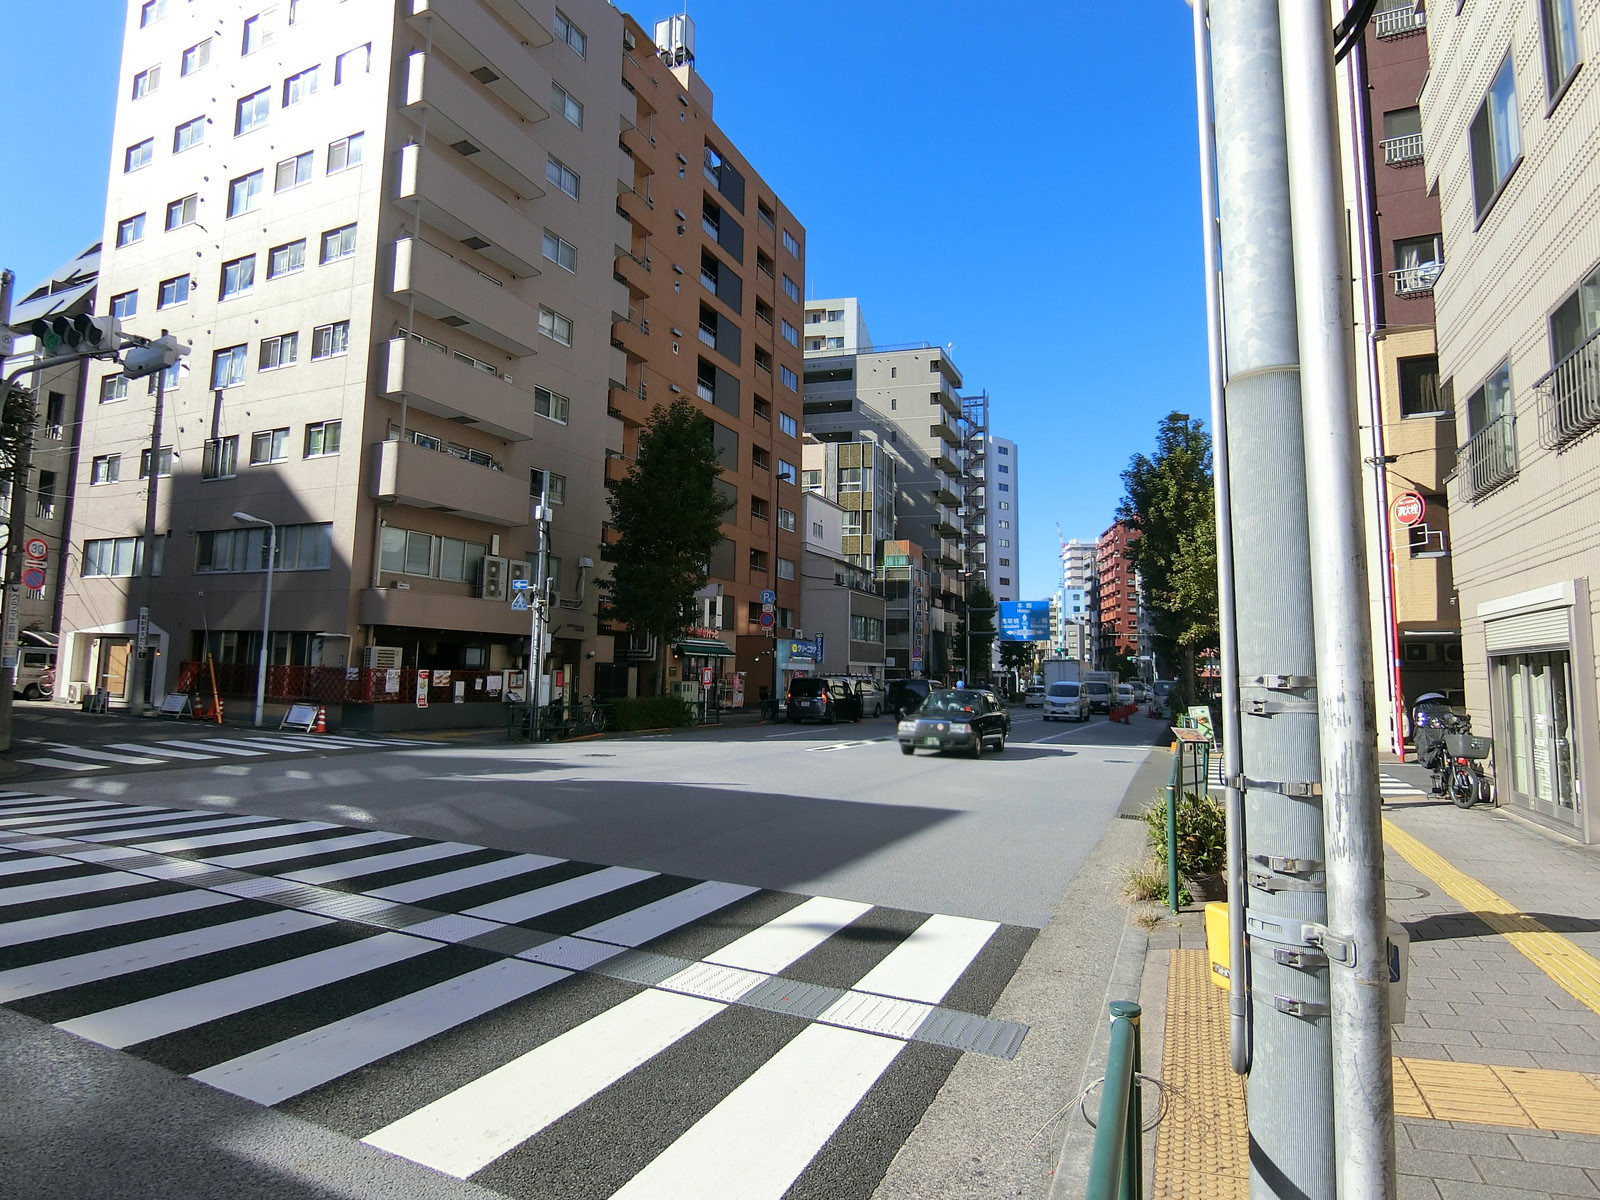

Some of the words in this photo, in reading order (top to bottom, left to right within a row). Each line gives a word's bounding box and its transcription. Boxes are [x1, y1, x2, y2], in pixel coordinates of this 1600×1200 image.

[1397, 504, 1418, 517] 消火栓
[31, 543, 45, 554] 30
[798, 644, 816, 653] クリーニング
